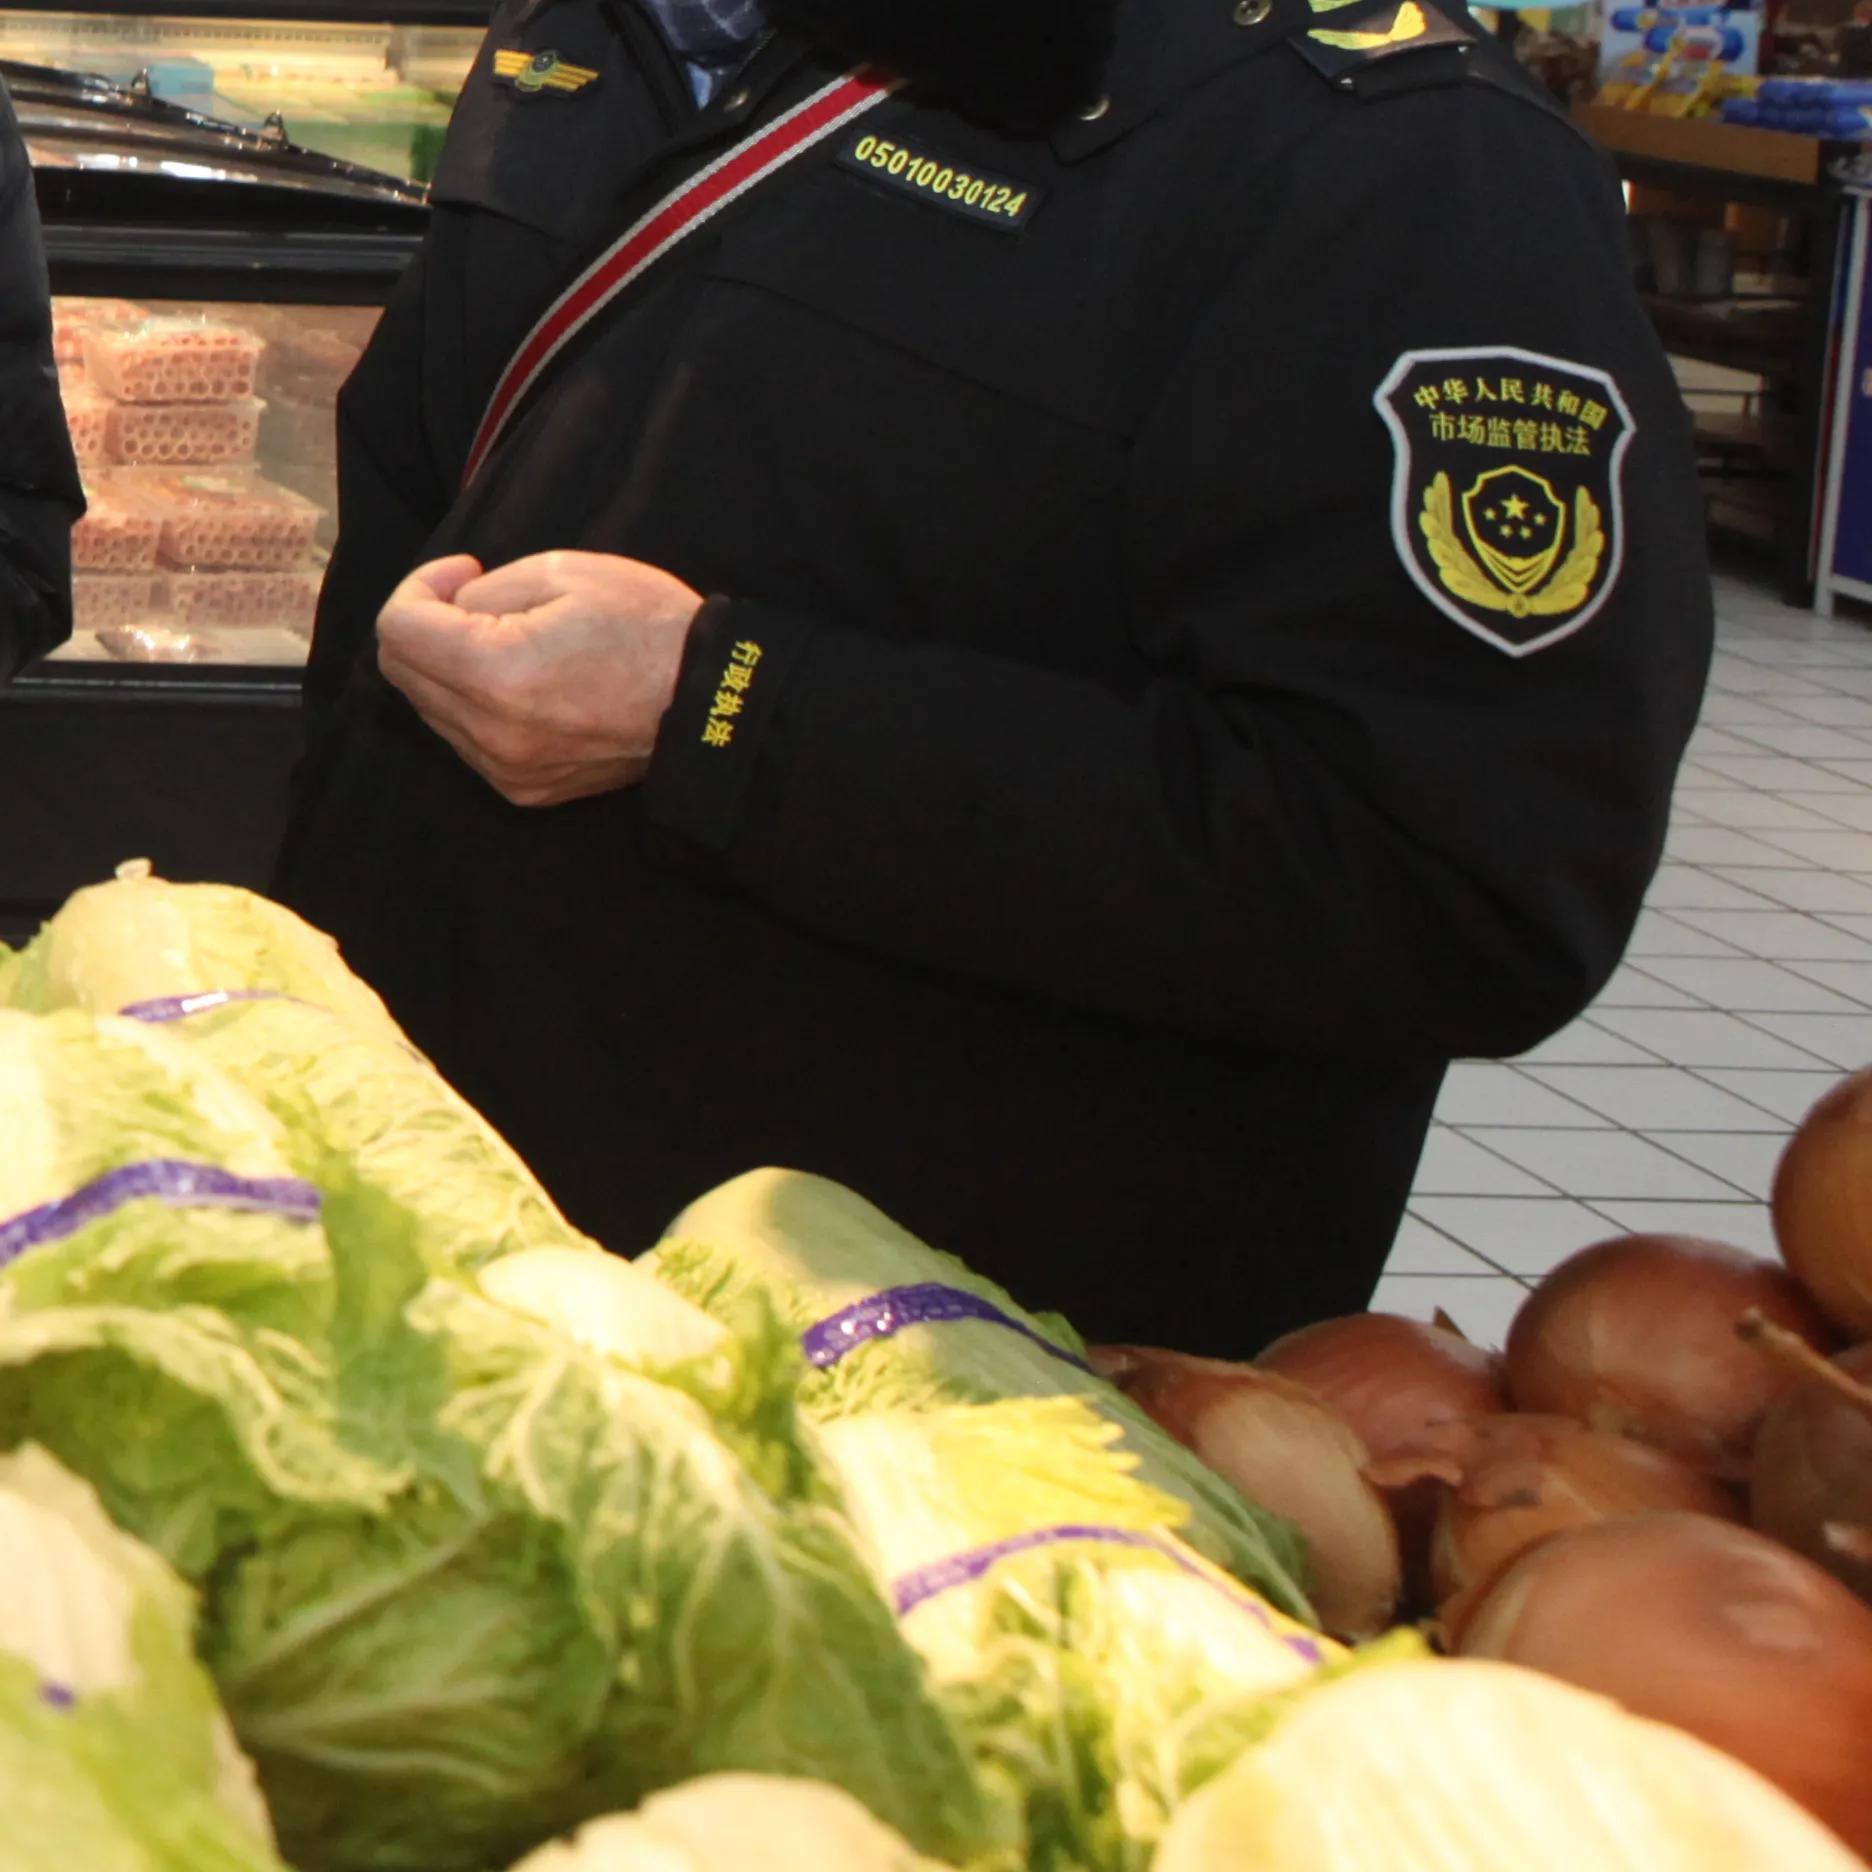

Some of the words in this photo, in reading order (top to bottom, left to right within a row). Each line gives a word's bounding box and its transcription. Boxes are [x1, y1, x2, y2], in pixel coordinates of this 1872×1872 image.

[854, 135, 1027, 217] 05010030124
[1414, 377, 1608, 430] 中华人民共和国
[1429, 411, 1591, 456] 市场监管执法
[700, 639, 764, 748] 行政执法
